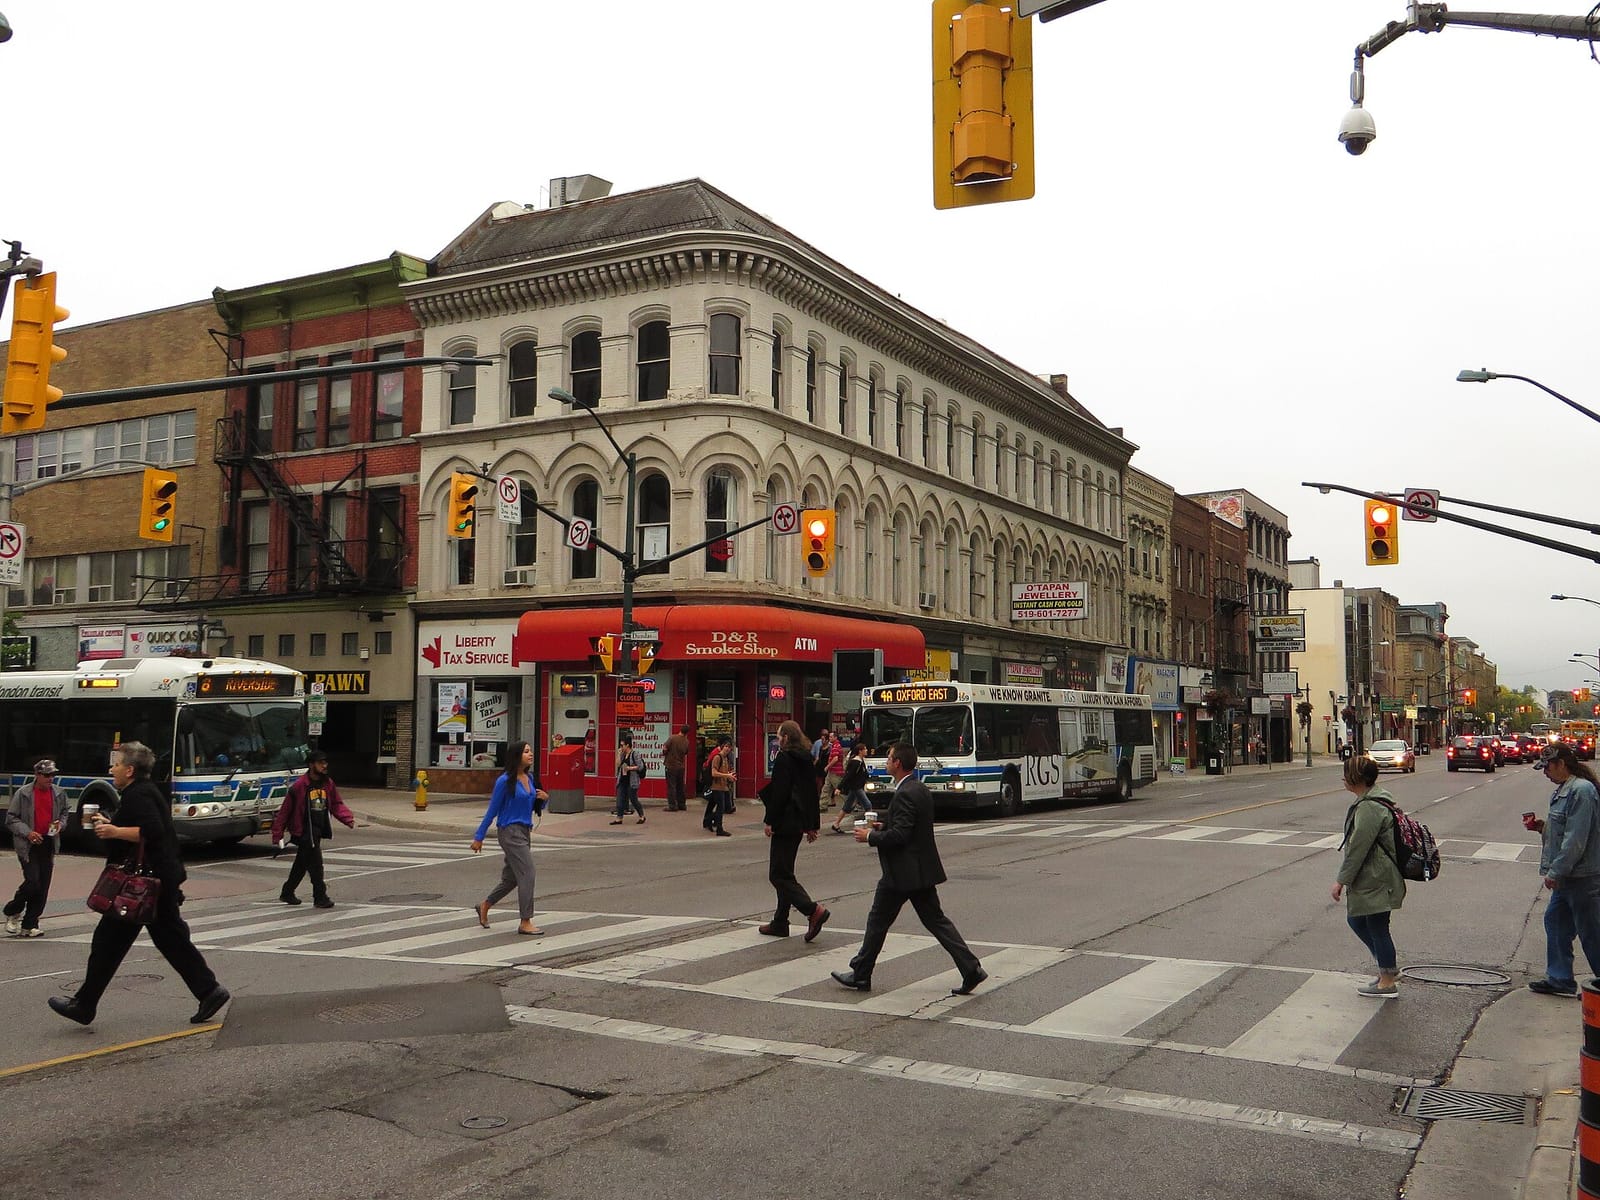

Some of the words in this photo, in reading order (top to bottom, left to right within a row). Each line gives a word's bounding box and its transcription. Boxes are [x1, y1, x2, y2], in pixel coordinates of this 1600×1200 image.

[1026, 584, 1070, 592] O'TAPAN
[1018, 592, 1078, 600] JEWELLERY
[1018, 610, 1078, 618] 519-601-7277
[146, 632, 176, 644] QUICK
[178, 630, 199, 642] CAS
[456, 634, 496, 647] LIBERTY
[712, 632, 727, 643] D
[728, 632, 744, 642] &
[747, 632, 759, 643] R
[686, 644, 742, 655] Smoke
[743, 644, 778, 657] Shop
[794, 638, 818, 651] ATM
[443, 652, 462, 664] TAX
[466, 651, 508, 664] SERVICE
[225, 678, 277, 692] RIVERSIDE
[315, 674, 366, 691] PAWN
[0, 685, 26, 698] ondon
[30, 684, 64, 697] transit
[770, 688, 786, 698] OPEN
[880, 691, 892, 702] 4A
[896, 689, 926, 701] OXFORD
[928, 688, 948, 700] EAST
[989, 688, 1001, 700] WE
[1002, 689, 1023, 702] KNOW
[1024, 690, 1052, 702] GRANITE.
[475, 694, 502, 711] Family
[1081, 694, 1102, 704] LUXURY
[1102, 694, 1114, 705] YOU
[1114, 695, 1124, 705] CAN
[480, 708, 495, 718] Tax
[486, 718, 501, 729] Cut
[1025, 756, 1060, 786] RGS
